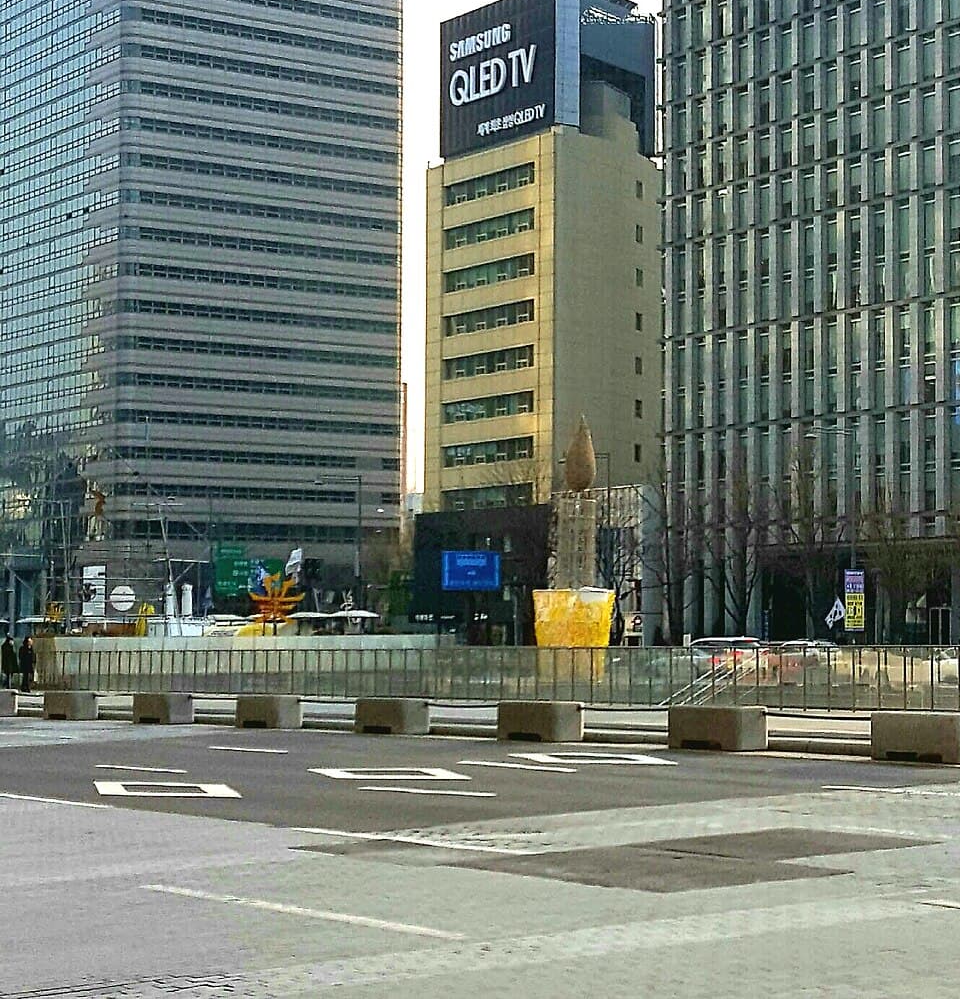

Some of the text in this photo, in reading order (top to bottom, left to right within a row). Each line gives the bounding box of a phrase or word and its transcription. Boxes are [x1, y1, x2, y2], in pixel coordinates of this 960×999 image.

[449, 23, 512, 61] SAMSUNG
[449, 44, 537, 106] QLED TV
[514, 108, 535, 125] QLED
[533, 103, 546, 120] TV
